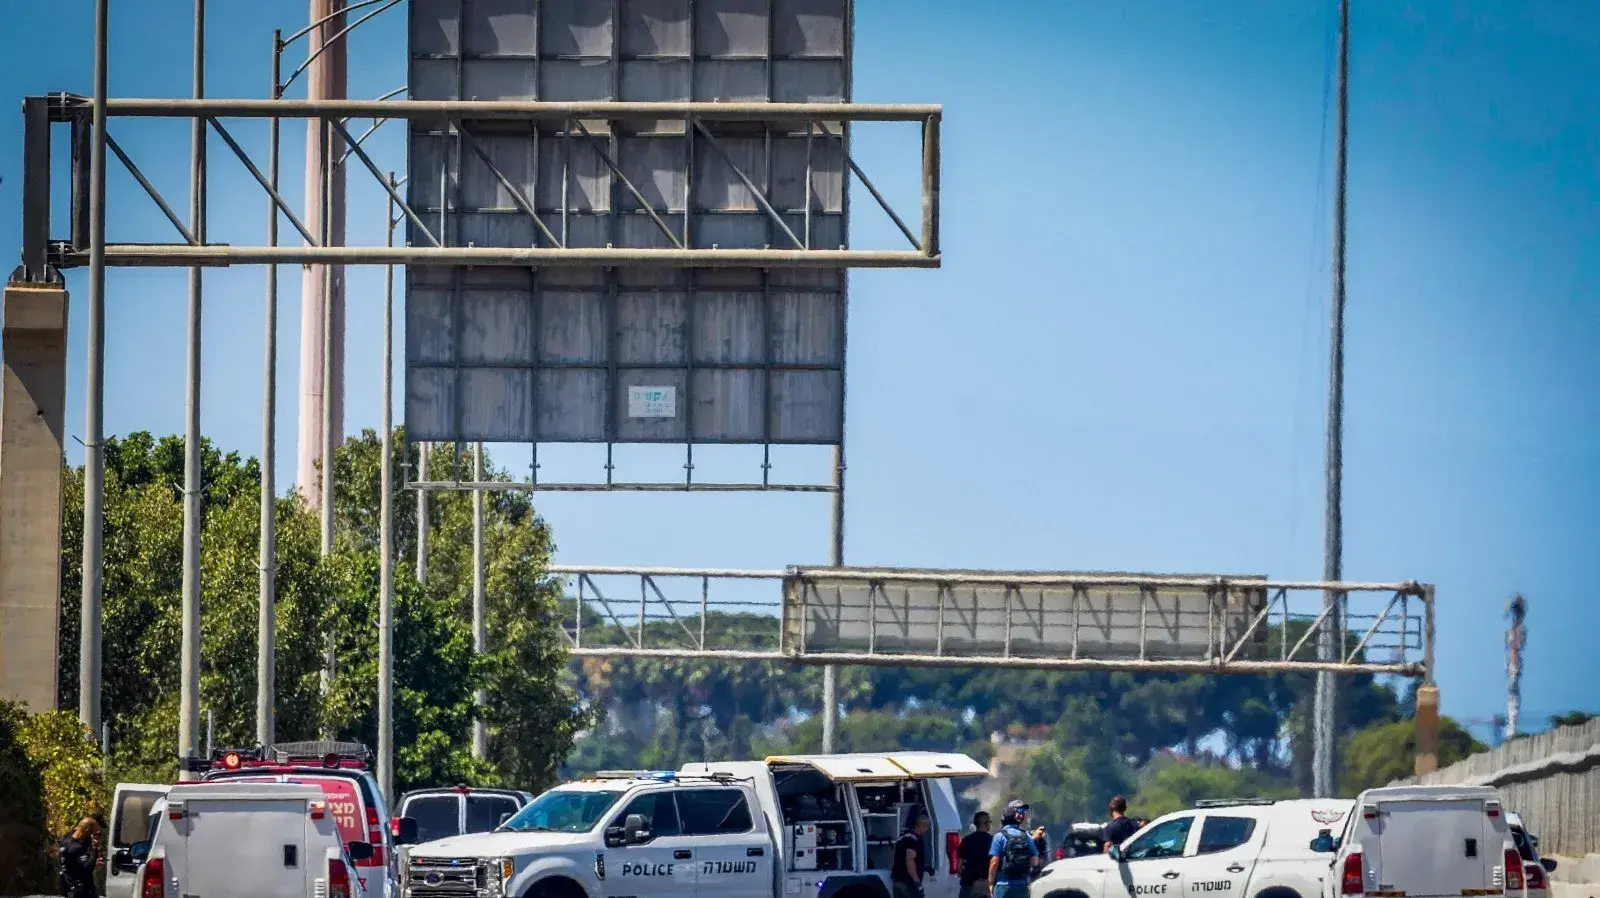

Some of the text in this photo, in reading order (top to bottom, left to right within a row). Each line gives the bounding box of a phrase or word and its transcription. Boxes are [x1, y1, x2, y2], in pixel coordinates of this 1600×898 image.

[622, 863, 674, 877] POLICE
[703, 861, 757, 874] משטרה
[1128, 884, 1168, 895] POLICE
[1191, 880, 1232, 892] משטרה
